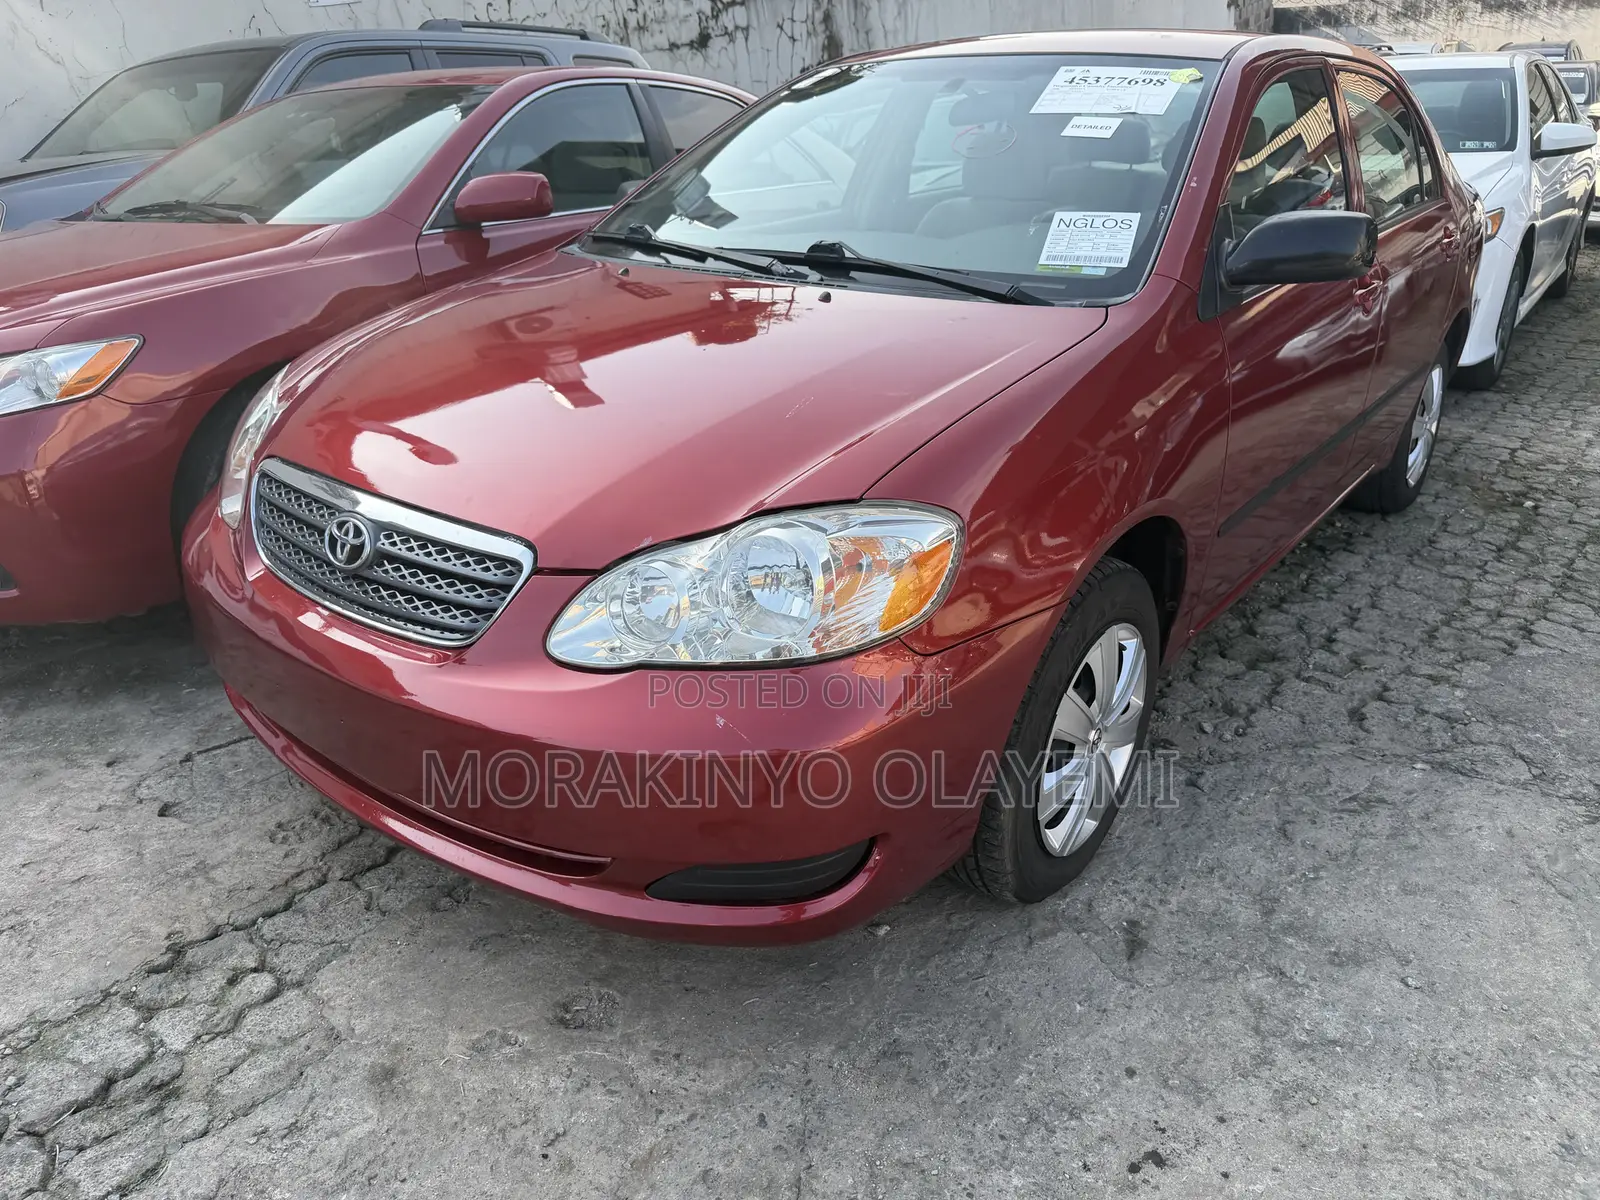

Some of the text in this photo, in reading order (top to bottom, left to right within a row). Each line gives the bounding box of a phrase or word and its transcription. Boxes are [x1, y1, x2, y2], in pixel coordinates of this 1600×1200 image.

[1063, 75, 1168, 87] 45377698
[1070, 123, 1112, 131] DETAILED
[1057, 217, 1133, 230] NGLOS
